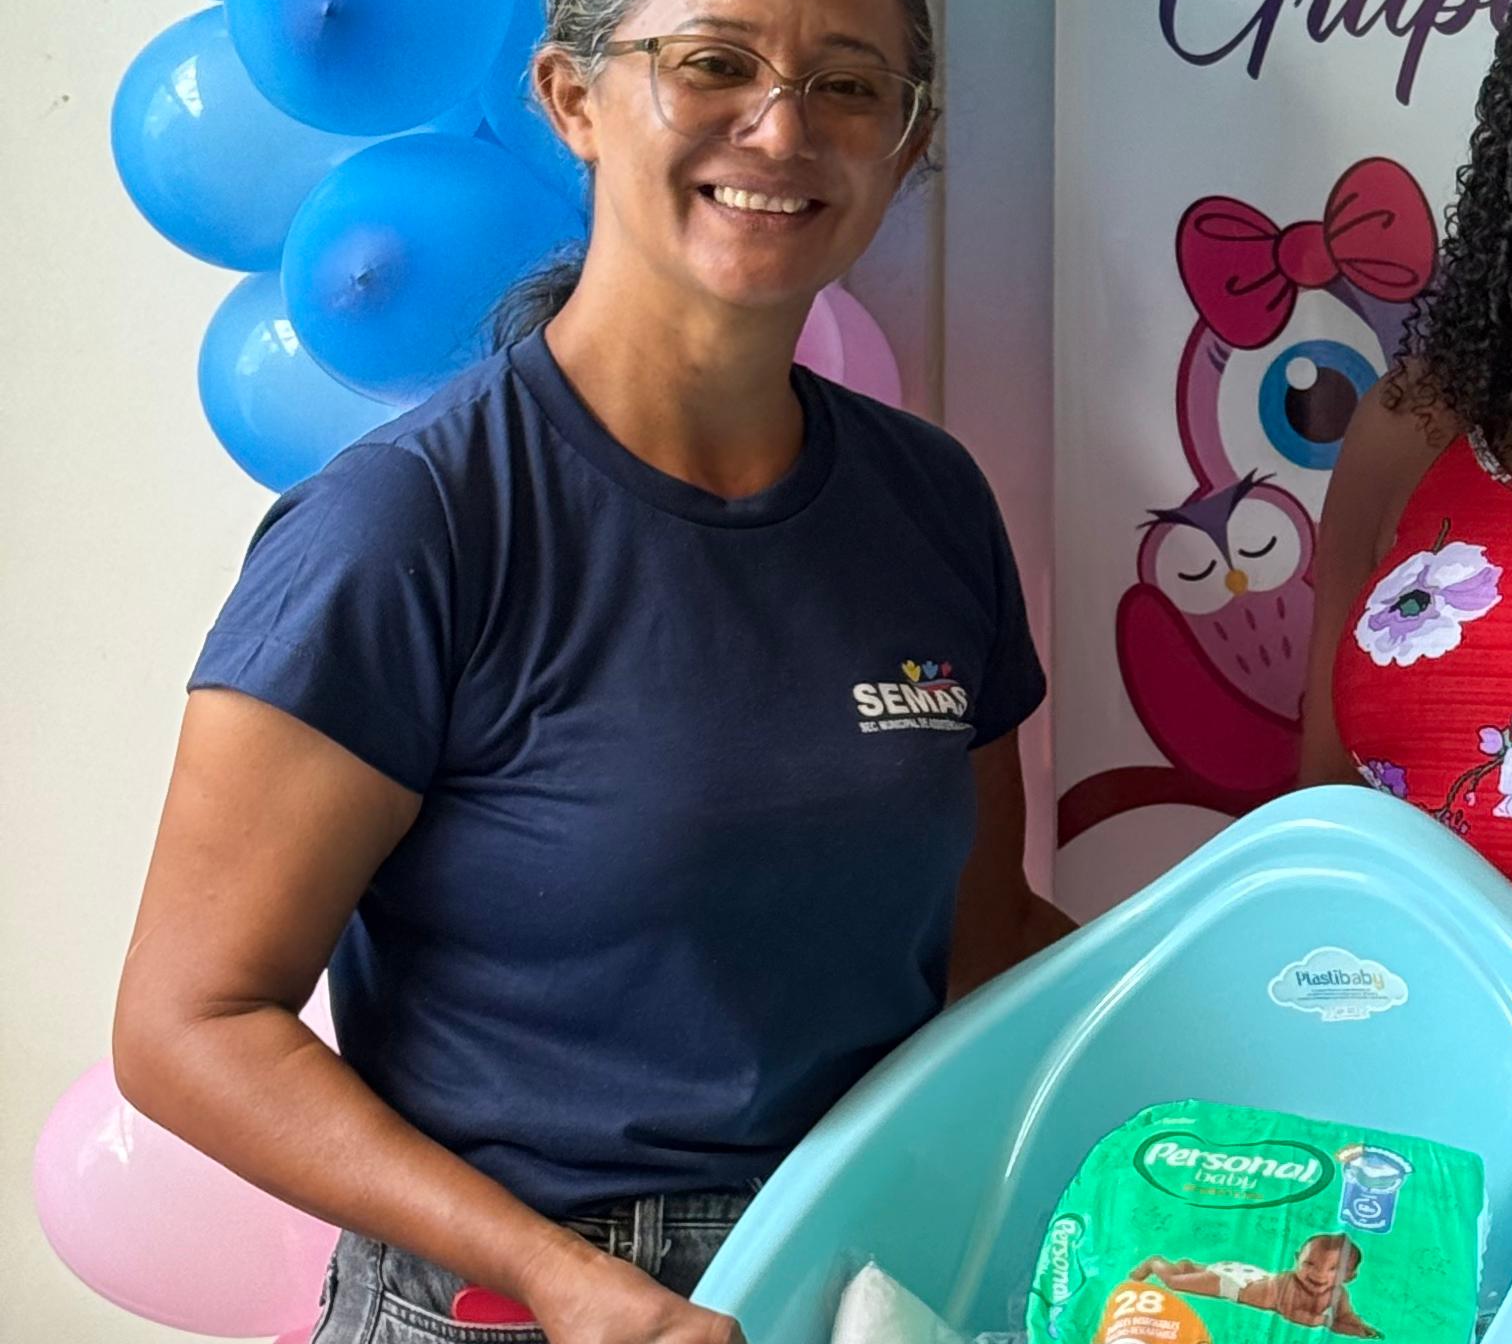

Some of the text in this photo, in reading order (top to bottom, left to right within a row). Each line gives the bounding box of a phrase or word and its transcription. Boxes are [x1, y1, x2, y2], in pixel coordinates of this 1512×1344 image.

[853, 683, 968, 718] SEMAS
[1144, 1142, 1317, 1183] Personal
[1195, 1168, 1257, 1190] baby
[1050, 1219, 1078, 1304] Personal
[1112, 1290, 1165, 1319] 28
